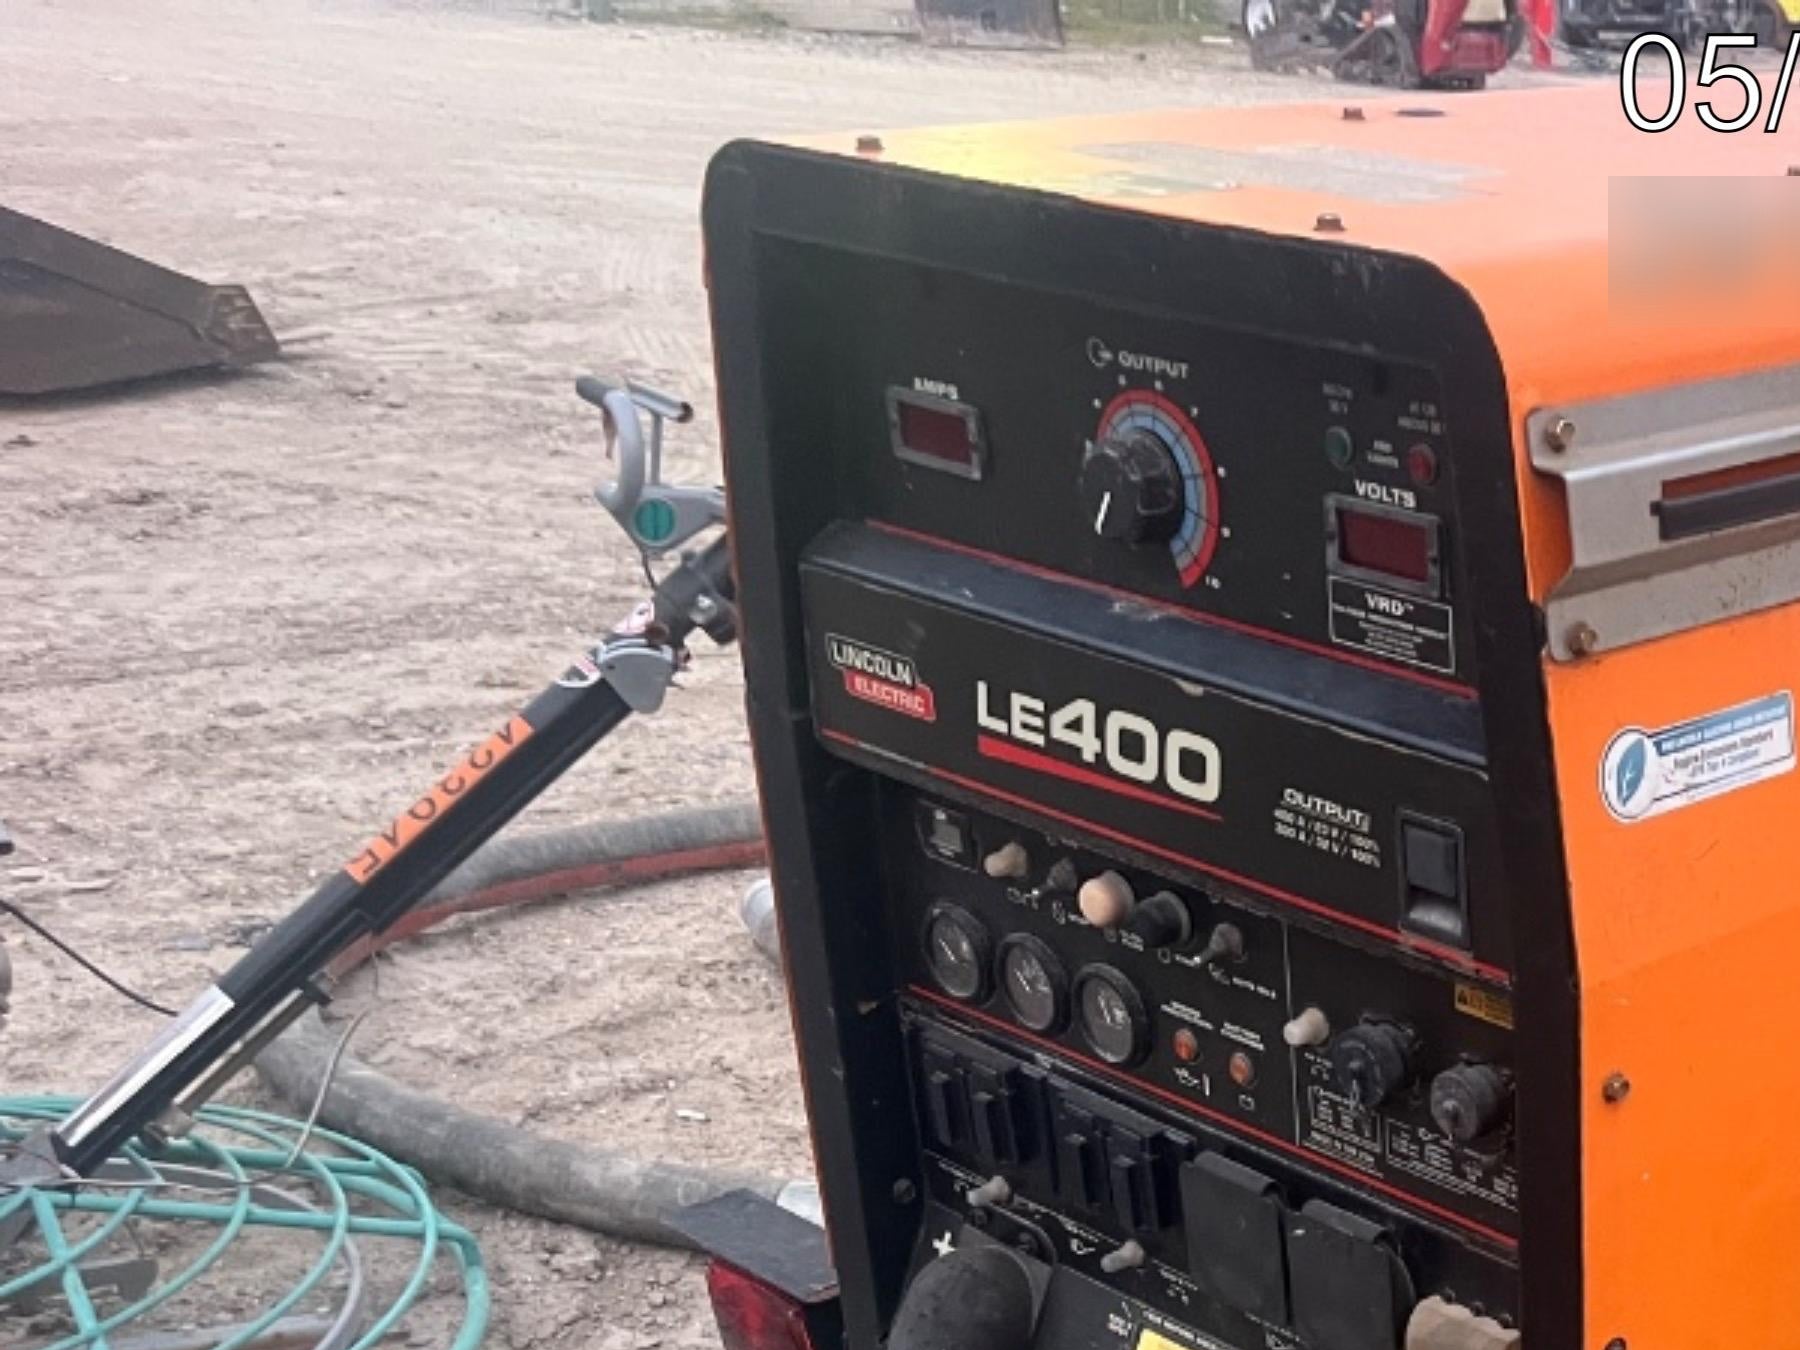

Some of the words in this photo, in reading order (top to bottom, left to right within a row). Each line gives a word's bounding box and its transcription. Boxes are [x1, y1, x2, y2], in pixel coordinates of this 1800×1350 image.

[1118, 350, 1189, 379] OUTPUT
[1354, 479, 1417, 510] VOLTS
[831, 639, 914, 686] LINCOLN
[853, 675, 928, 714] ELECTRIC
[975, 680, 1222, 803] LE400
